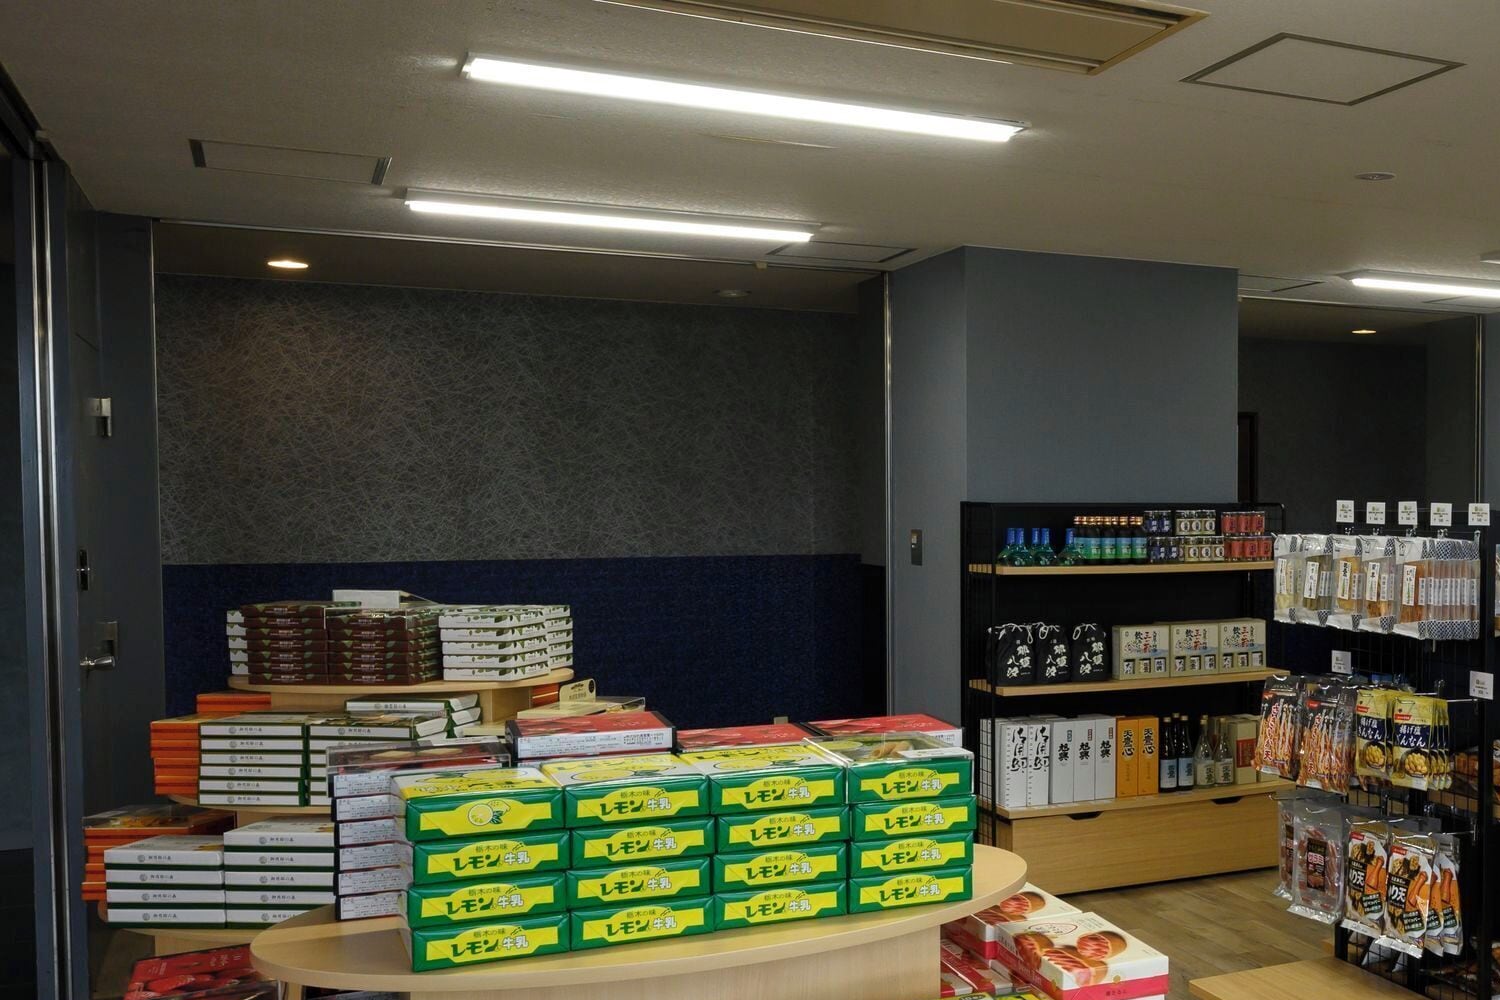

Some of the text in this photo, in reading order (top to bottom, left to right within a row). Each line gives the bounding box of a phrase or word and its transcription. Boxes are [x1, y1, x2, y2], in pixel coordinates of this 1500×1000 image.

[1400, 725, 1421, 735] 揚げ塩
[744, 786, 810, 803] レモン牛乳
[881, 779, 942, 796] レモン牛乳
[600, 799, 671, 816] レモン牛乳
[884, 814, 944, 830] レモン牛乳
[750, 824, 815, 841] レモン牛乳
[606, 838, 676, 856] レモン牛乳
[453, 854, 530, 871] レモン牛乳
[881, 849, 941, 866] レモン牛乳
[746, 862, 811, 880] レモン牛乳
[600, 878, 672, 896] レモン牛乳
[880, 885, 940, 902] レモン牛乳
[446, 896, 524, 914] レモン牛乳
[746, 900, 811, 918] レモン牛乳
[606, 917, 676, 936] レモン牛乳
[451, 938, 528, 956] レモン牛乳
